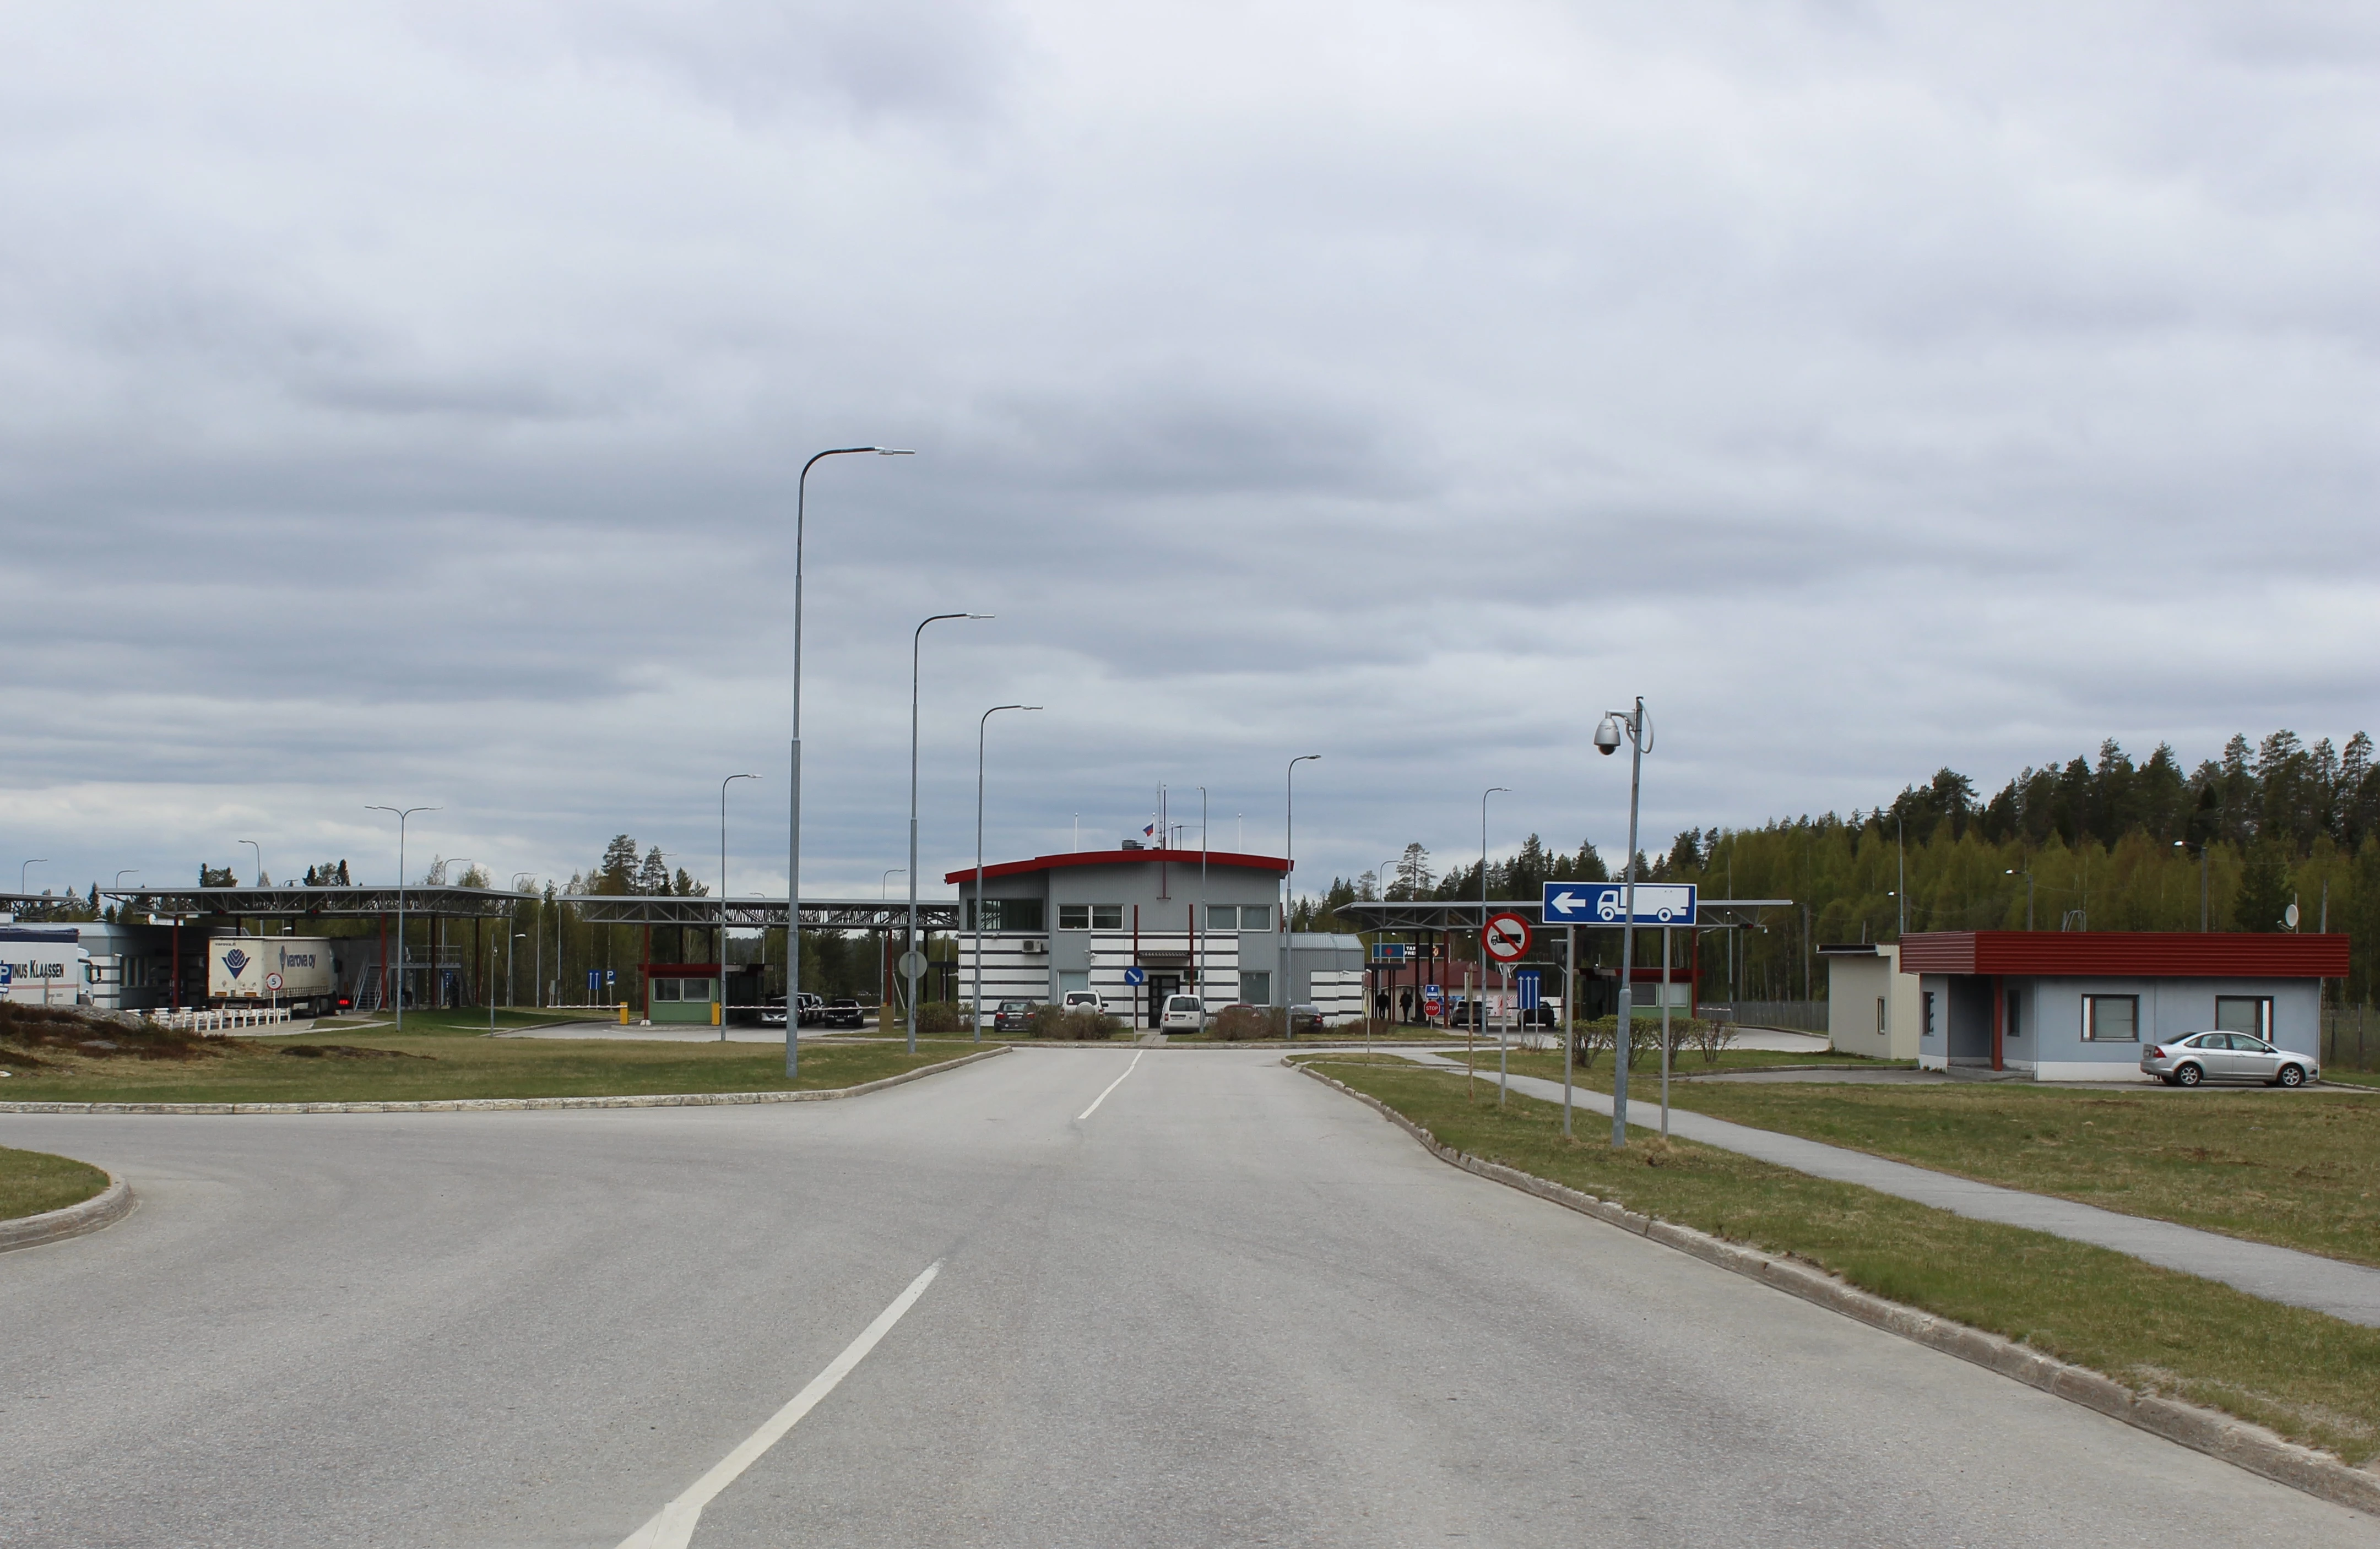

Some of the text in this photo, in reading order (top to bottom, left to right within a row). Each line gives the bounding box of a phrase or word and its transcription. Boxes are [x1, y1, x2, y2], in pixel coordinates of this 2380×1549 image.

[286, 954, 316, 969] varova oy
[11, 963, 28, 979] INUS
[607, 971, 614, 980] P
